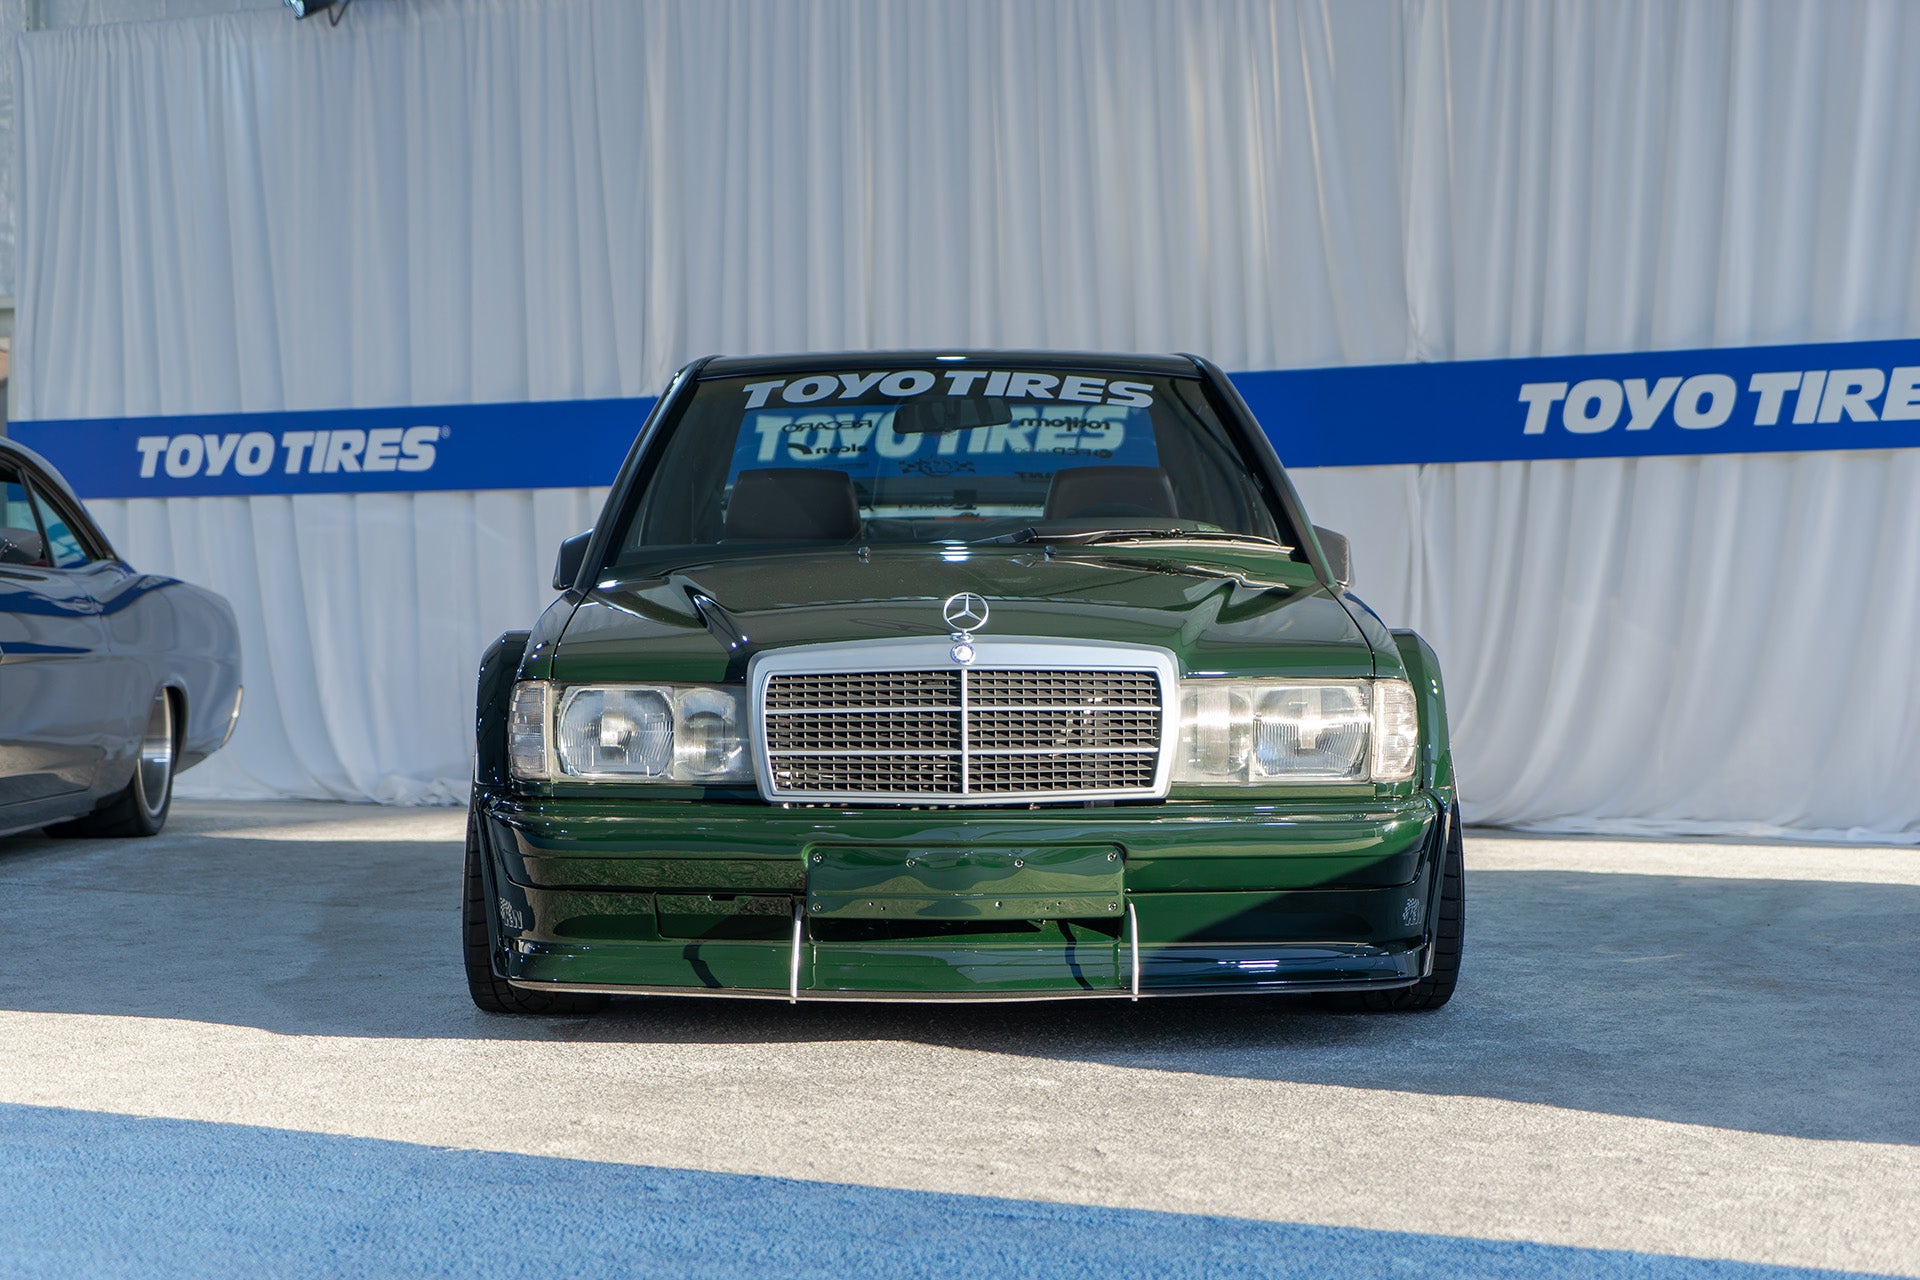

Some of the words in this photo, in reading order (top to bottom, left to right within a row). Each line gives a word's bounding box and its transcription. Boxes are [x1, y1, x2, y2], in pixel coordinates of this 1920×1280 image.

[742, 370, 936, 410] TOYO
[943, 370, 1154, 409] TIRES
[1518, 373, 1737, 435] TOYO
[136, 432, 274, 479] TOYO
[281, 426, 440, 475] TIRES
